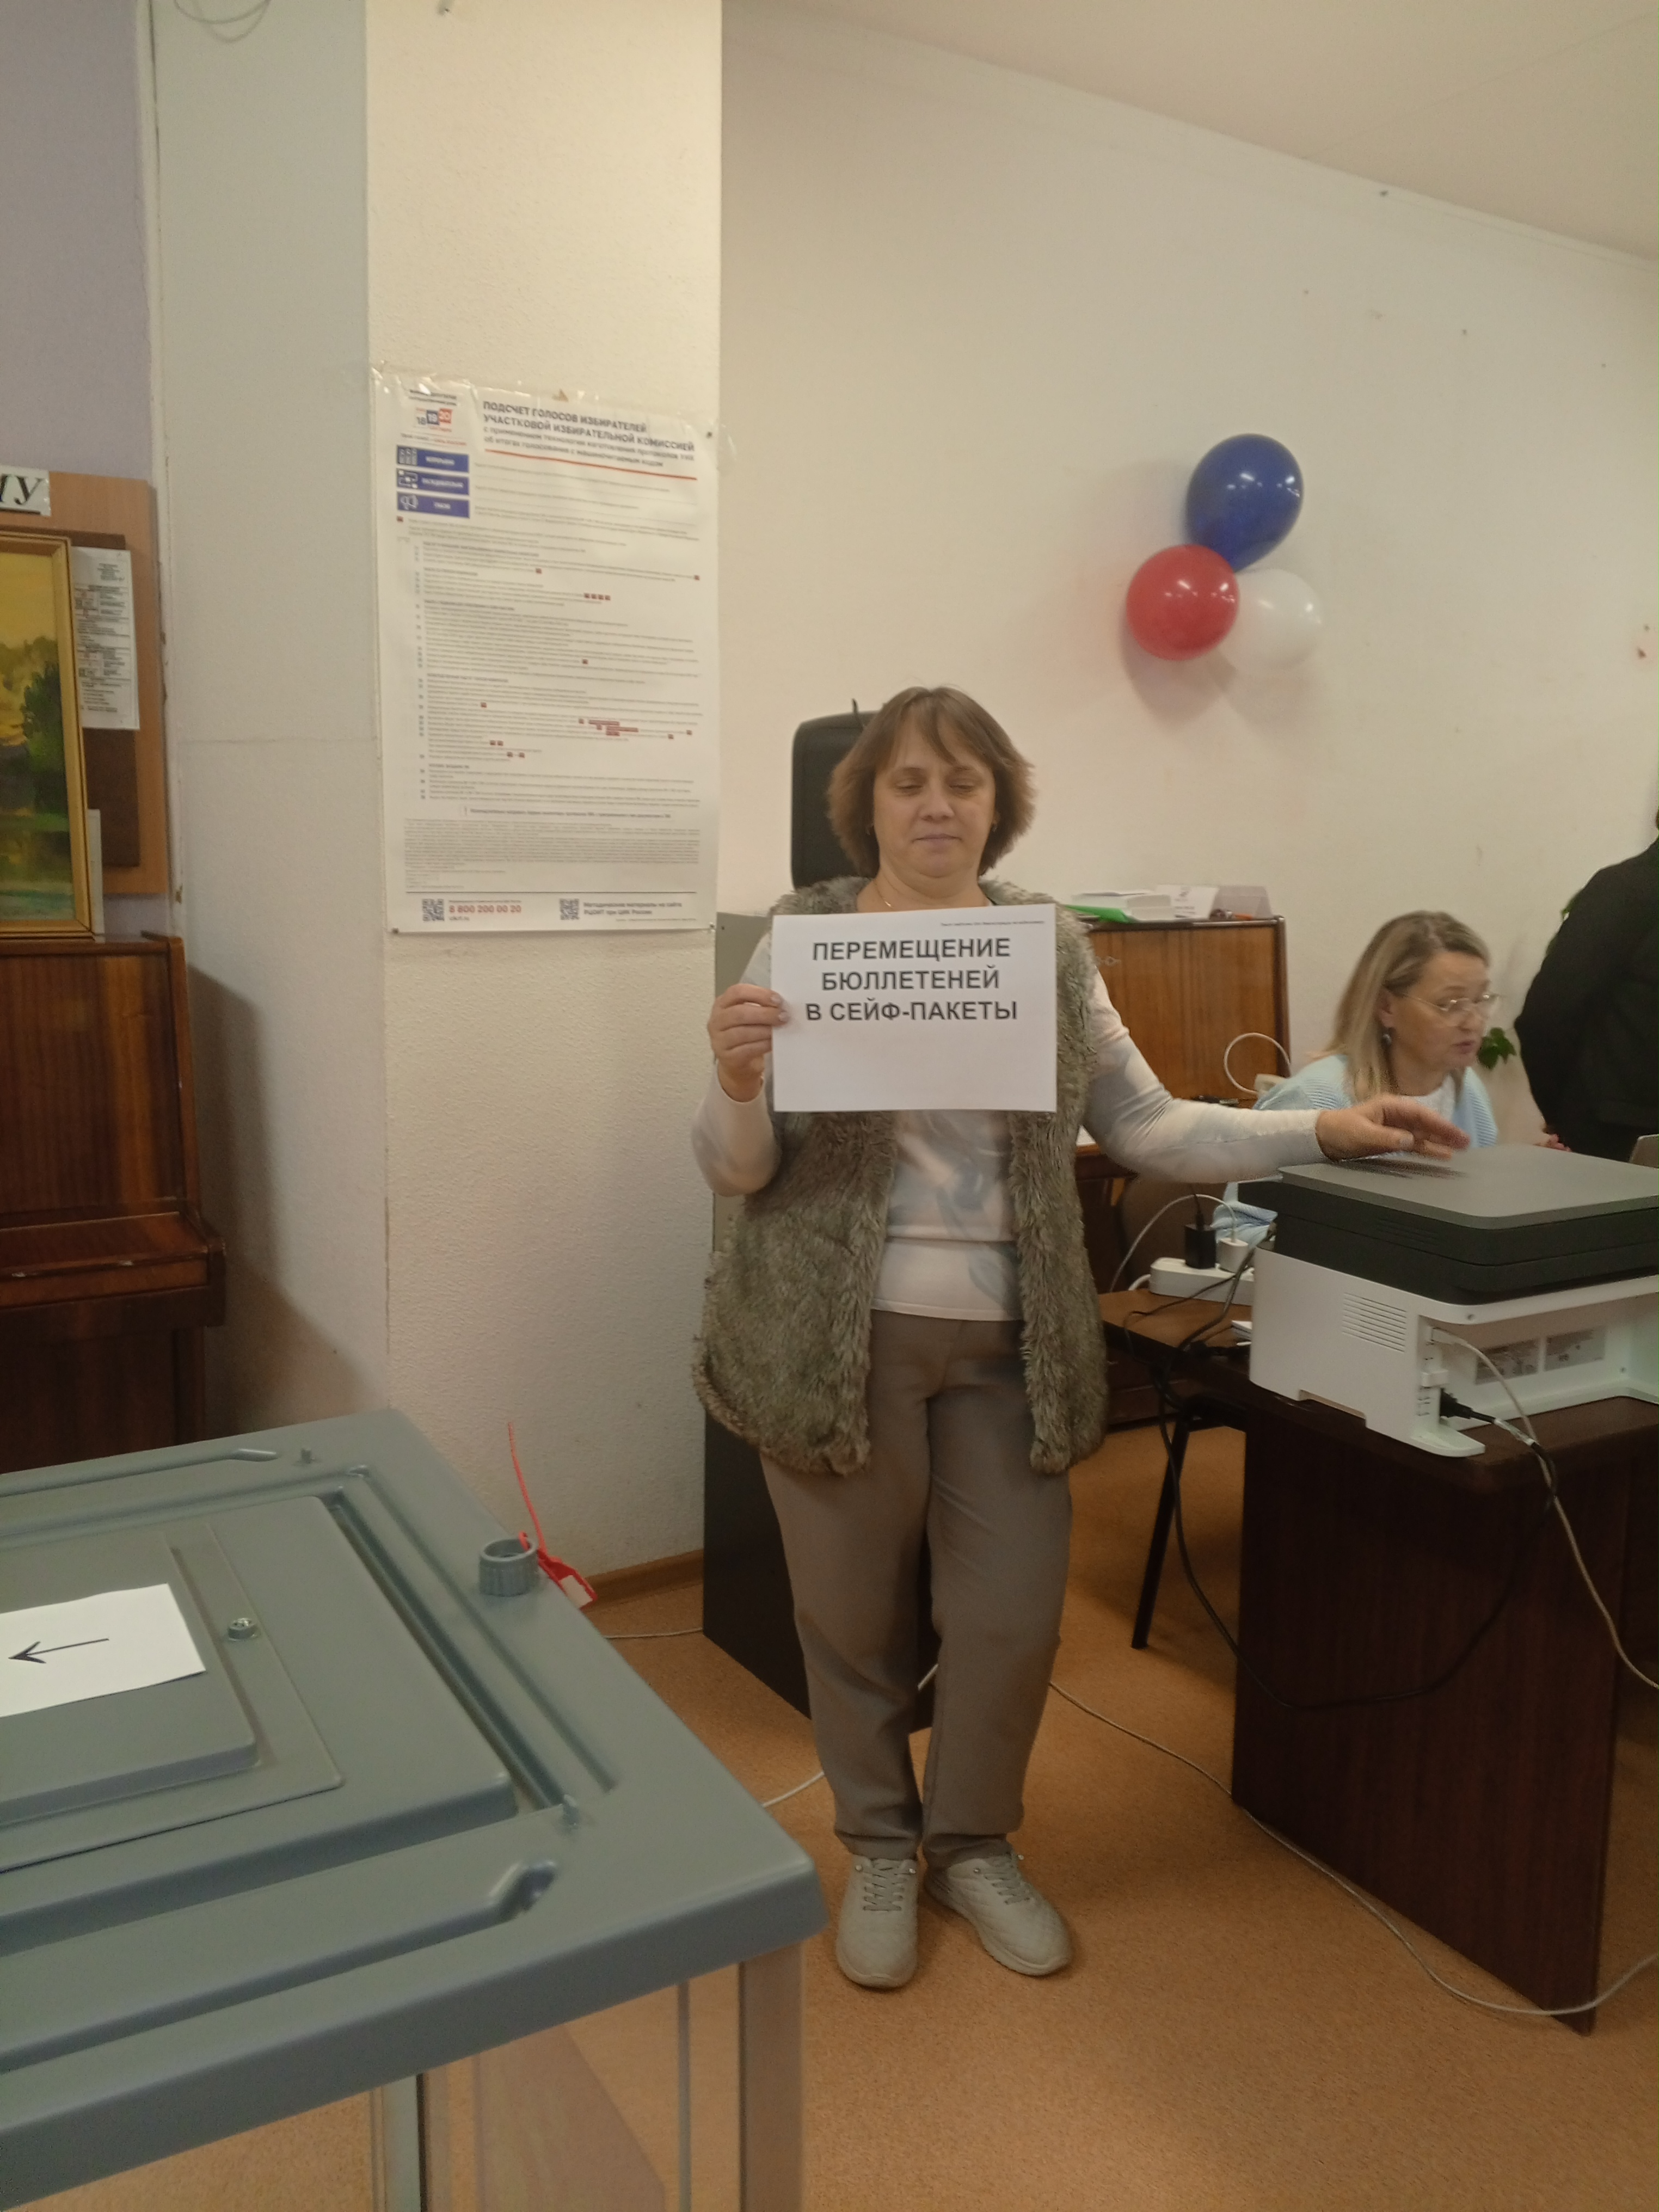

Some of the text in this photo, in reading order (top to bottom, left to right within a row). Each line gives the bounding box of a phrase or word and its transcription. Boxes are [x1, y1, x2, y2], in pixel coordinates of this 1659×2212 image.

[483, 401, 647, 433] ПОДСЧЕТ ГОЛОСОВ ИЗБИРАТЕЛЕЙ
[483, 414, 695, 451] УЧАСТКОВОЙ ИЗБИРАТЕЛЬНОЙ КОМИССИЕЙ
[449, 905, 455, 913] 8
[457, 905, 475, 913] 800
[477, 905, 494, 913] 200
[510, 905, 521, 913] 20
[812, 937, 1011, 962] ПЕРЕМЕЩЕНИЕ
[821, 964, 1000, 991] БЮЛЛЕТЕНЕЙ
[806, 997, 1018, 1021] В СЕЙФ-ПАКЕТЫ
